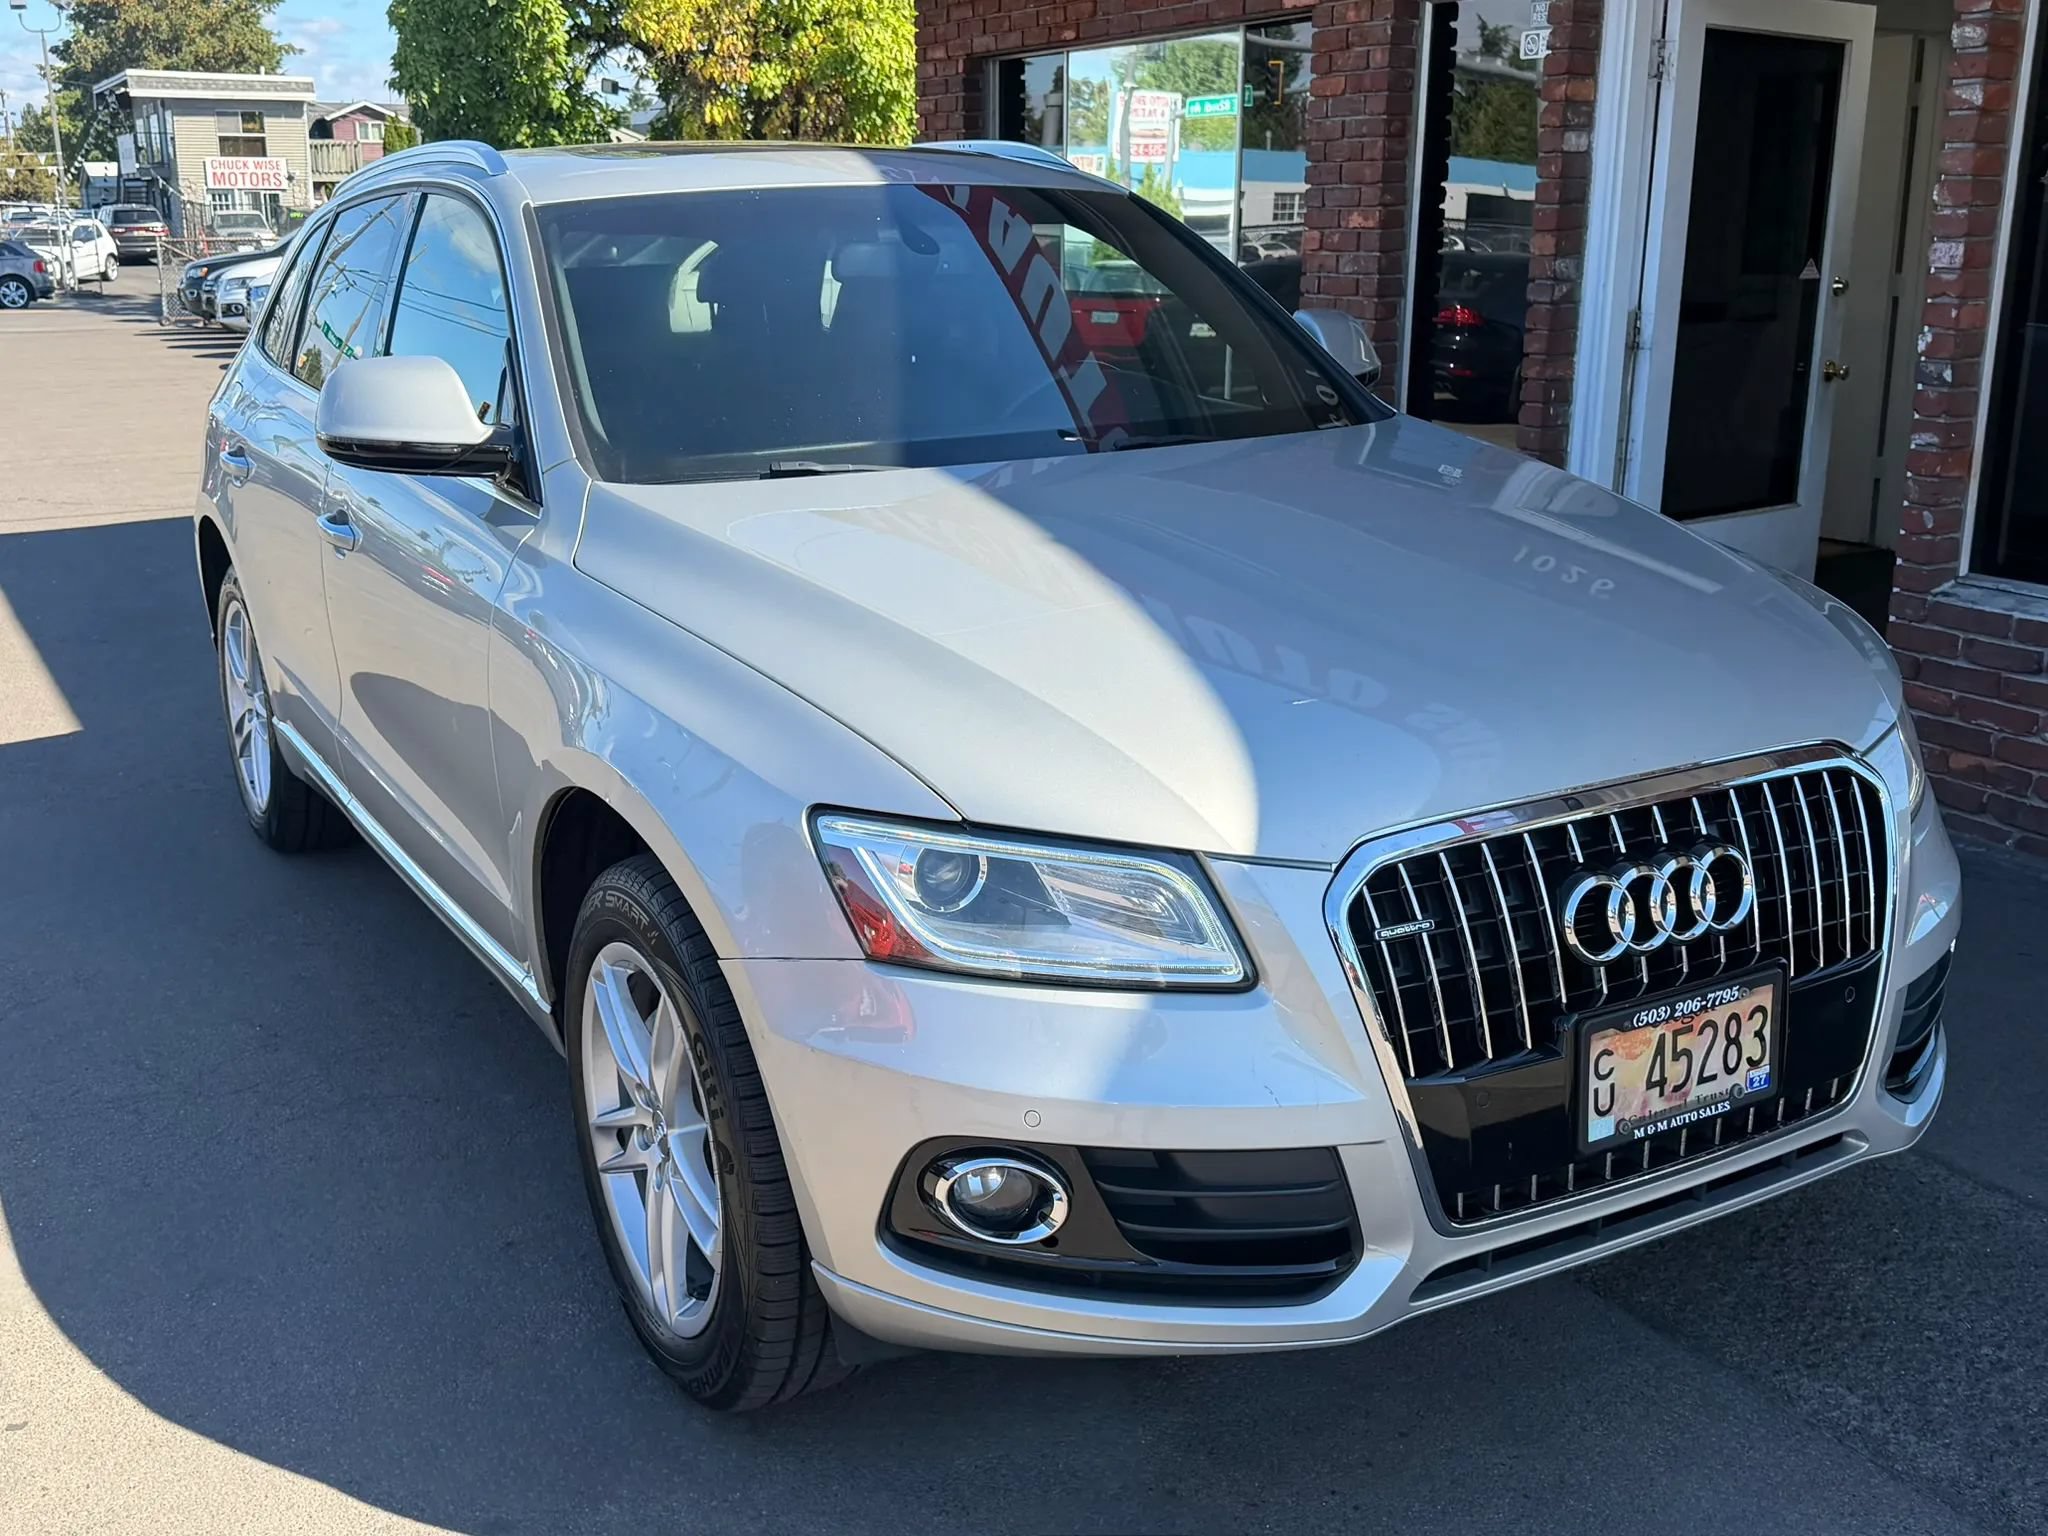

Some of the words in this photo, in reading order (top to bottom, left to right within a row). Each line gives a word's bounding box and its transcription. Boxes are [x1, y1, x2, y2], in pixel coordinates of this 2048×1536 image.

[211, 160, 249, 170] CHUCK
[253, 160, 281, 170] WISE
[212, 171, 282, 187] MOTORS
[605, 891, 650, 930] SMART
[1380, 922, 1430, 937] quattro
[1633, 1007, 1671, 1028] (503)
[1674, 986, 1740, 1017] 206-7795
[1645, 1004, 1769, 1098] 45283
[693, 1032, 725, 1121] Giti
[1752, 1074, 1767, 1087] 27
[1633, 1127, 1645, 1140] M
[1657, 1120, 1669, 1132] M
[1670, 1110, 1699, 1128] AUTO
[1699, 1101, 1731, 1118] SALES
